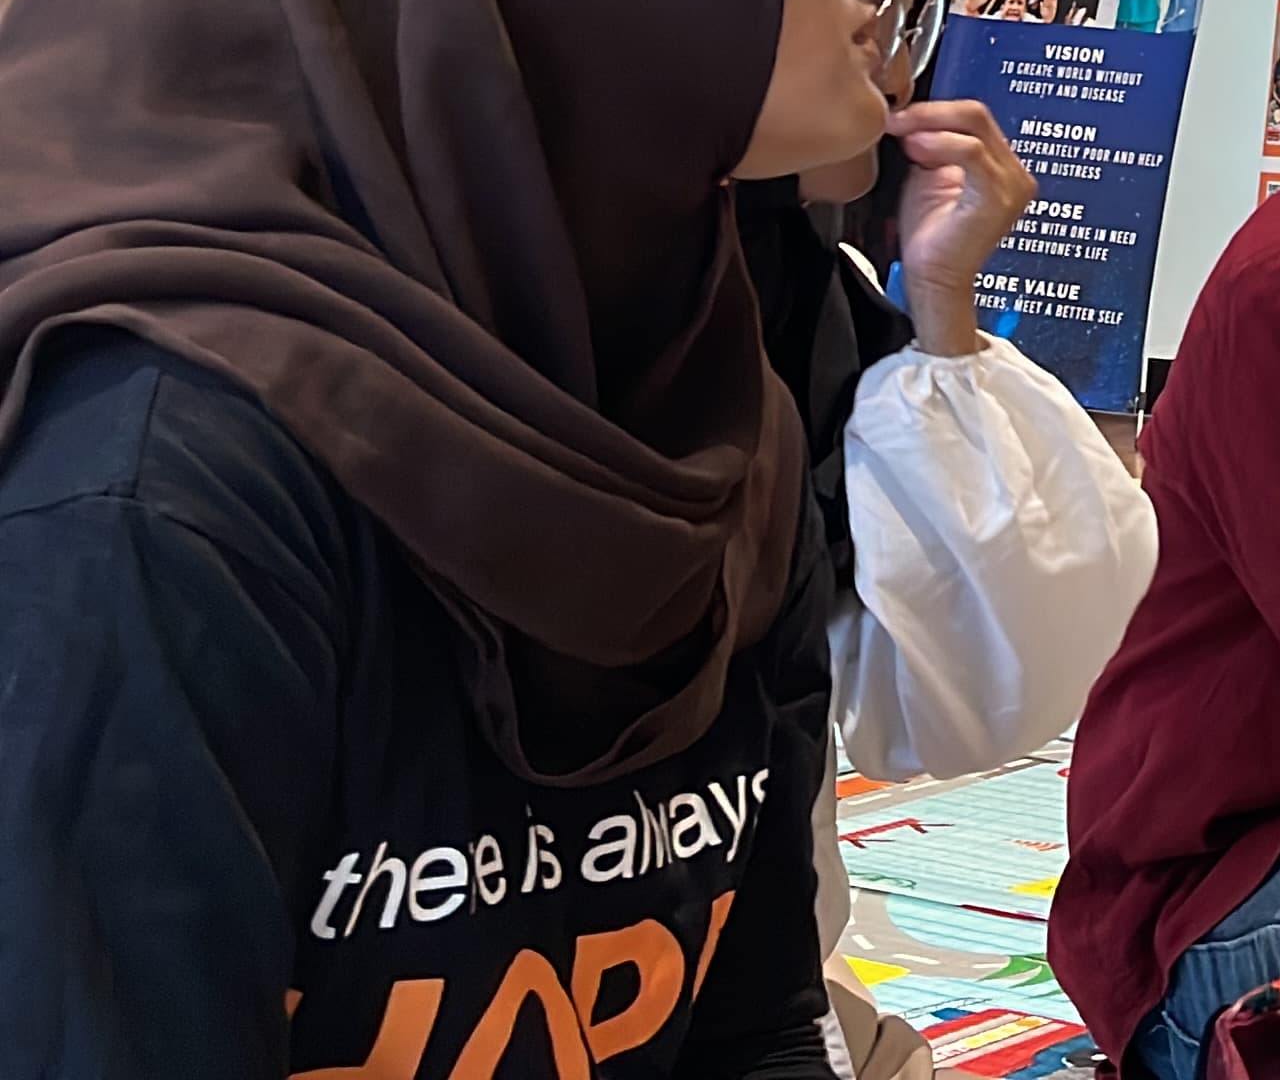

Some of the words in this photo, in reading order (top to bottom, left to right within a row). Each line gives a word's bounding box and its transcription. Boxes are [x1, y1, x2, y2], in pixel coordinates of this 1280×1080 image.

[1045, 44, 1104, 64] VISION
[1001, 61, 1013, 74] TO
[1017, 62, 1054, 78] CREATE
[1056, 66, 1092, 81] WORLD
[1095, 69, 1143, 86] WITHOUT
[1009, 80, 1053, 96] POVERTY
[1056, 84, 1078, 99] AND
[1080, 87, 1127, 104] DISEASE
[1020, 120, 1097, 142] MISSION
[1009, 139, 1081, 159] DESPERATELY
[1082, 149, 1111, 163] POOR
[1112, 151, 1135, 165] AND
[1137, 153, 1164, 168] HELP
[1035, 160, 1048, 174] IN
[1051, 162, 1102, 180] DISTRESS
[1040, 222, 1067, 237] WITH
[1070, 225, 1092, 240] ONE
[1094, 228, 1107, 242] IN
[1109, 229, 1137, 246] NEED
[1018, 238, 1082, 258] EVERYONE'S
[1084, 246, 1109, 262] LIFE
[973, 272, 1020, 293] CORE
[1024, 278, 1081, 301] VALUE
[1013, 298, 1043, 314] MEET
[1044, 303, 1053, 317] A
[1055, 304, 1095, 322] BETTER
[1098, 310, 1125, 325] SELF
